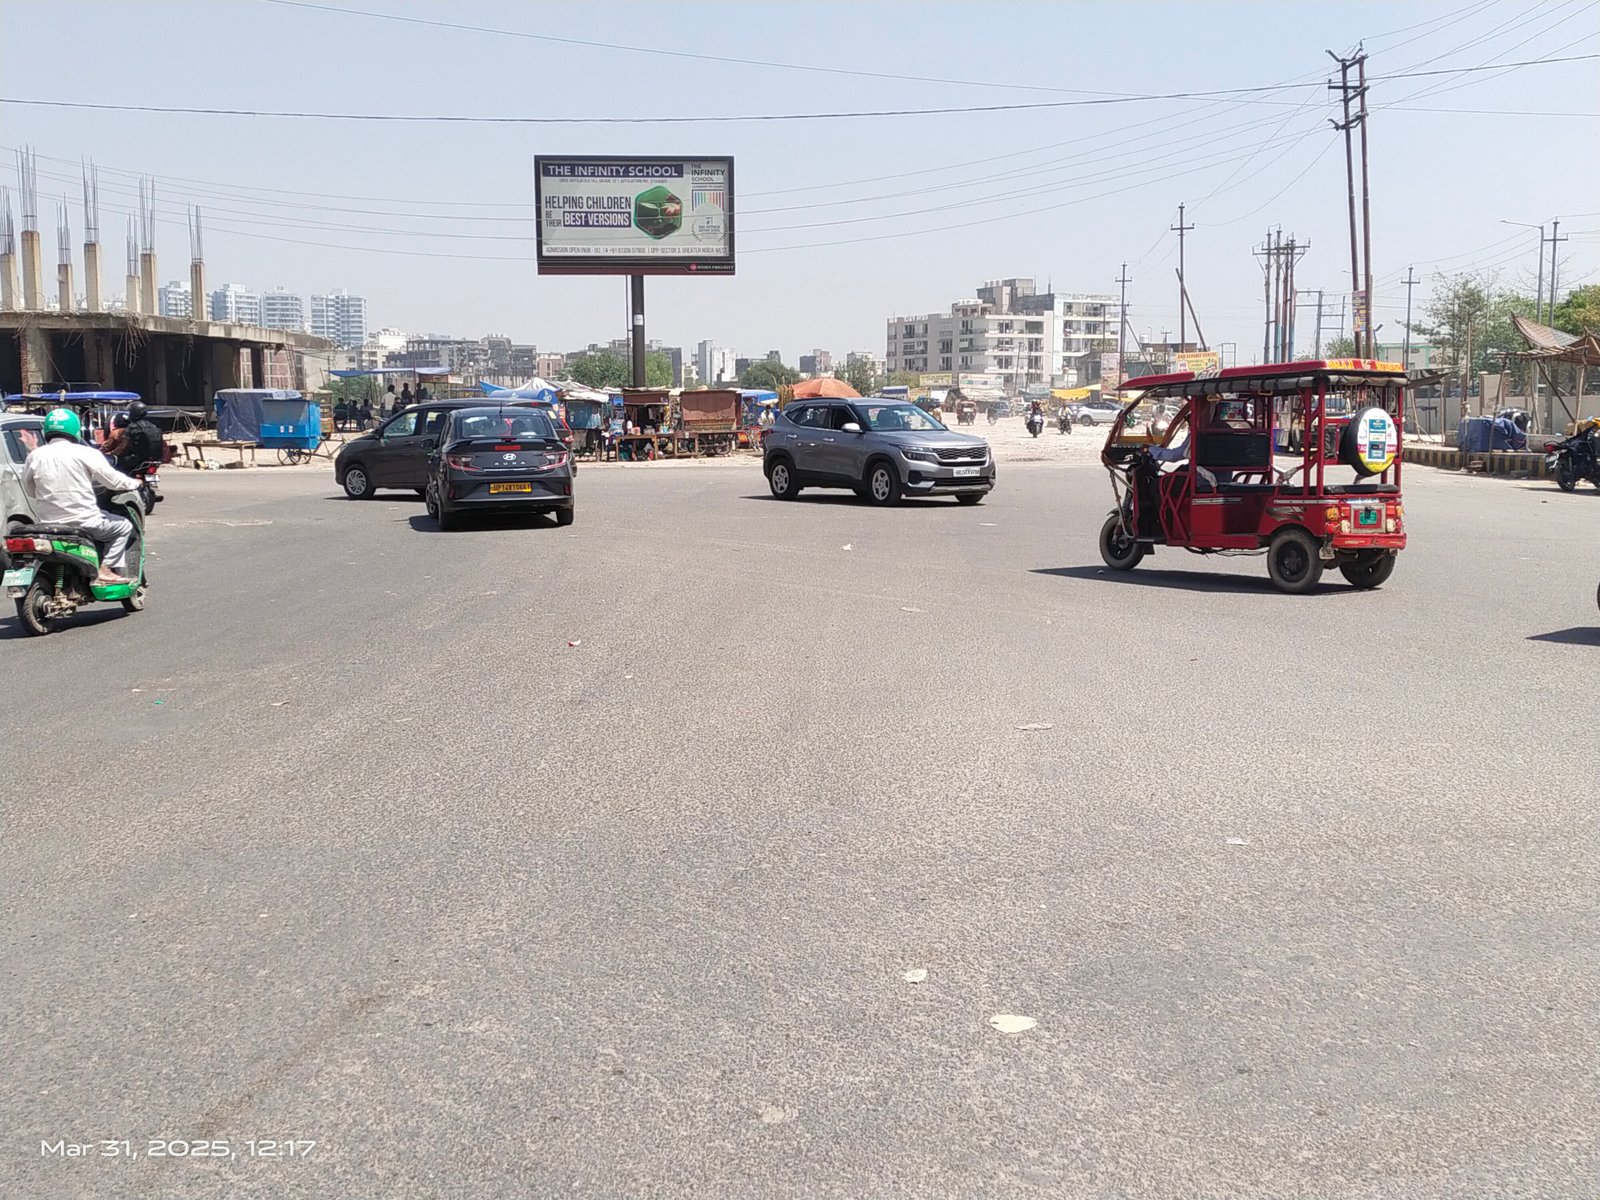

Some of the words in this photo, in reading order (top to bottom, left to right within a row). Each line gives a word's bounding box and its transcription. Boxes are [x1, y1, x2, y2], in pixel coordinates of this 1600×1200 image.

[547, 165, 571, 176] THE
[574, 165, 626, 176] INFINITY
[628, 166, 678, 176] SCHOOL
[545, 195, 584, 209] HELPING
[586, 196, 632, 209] CHILDREN
[545, 210, 553, 218] BE
[564, 212, 586, 225] BEST
[587, 213, 630, 226] VERSIONS
[545, 219, 562, 227] THEIR
